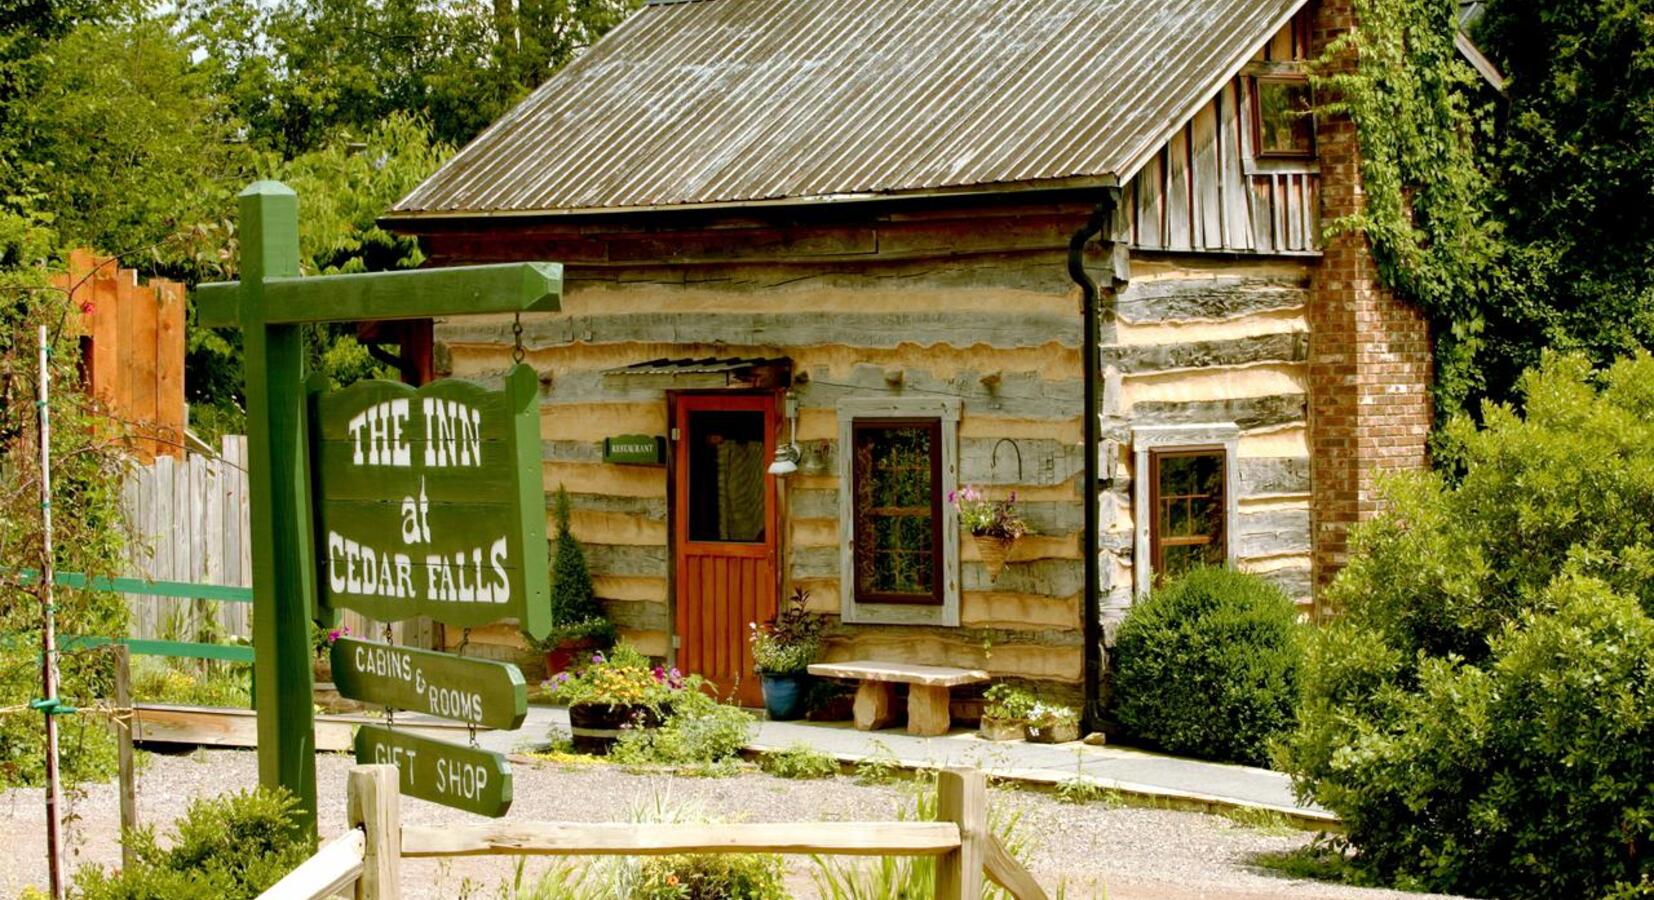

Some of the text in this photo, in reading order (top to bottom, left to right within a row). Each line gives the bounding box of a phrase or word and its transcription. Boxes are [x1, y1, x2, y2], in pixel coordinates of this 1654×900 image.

[349, 397, 481, 467] THE INN
[611, 444, 654, 454] RESTAURANT
[401, 474, 431, 544] at
[328, 530, 511, 604] CEDAR FALLS
[355, 646, 483, 723] CABINS & ROOMS
[436, 757, 488, 802] SHOP
